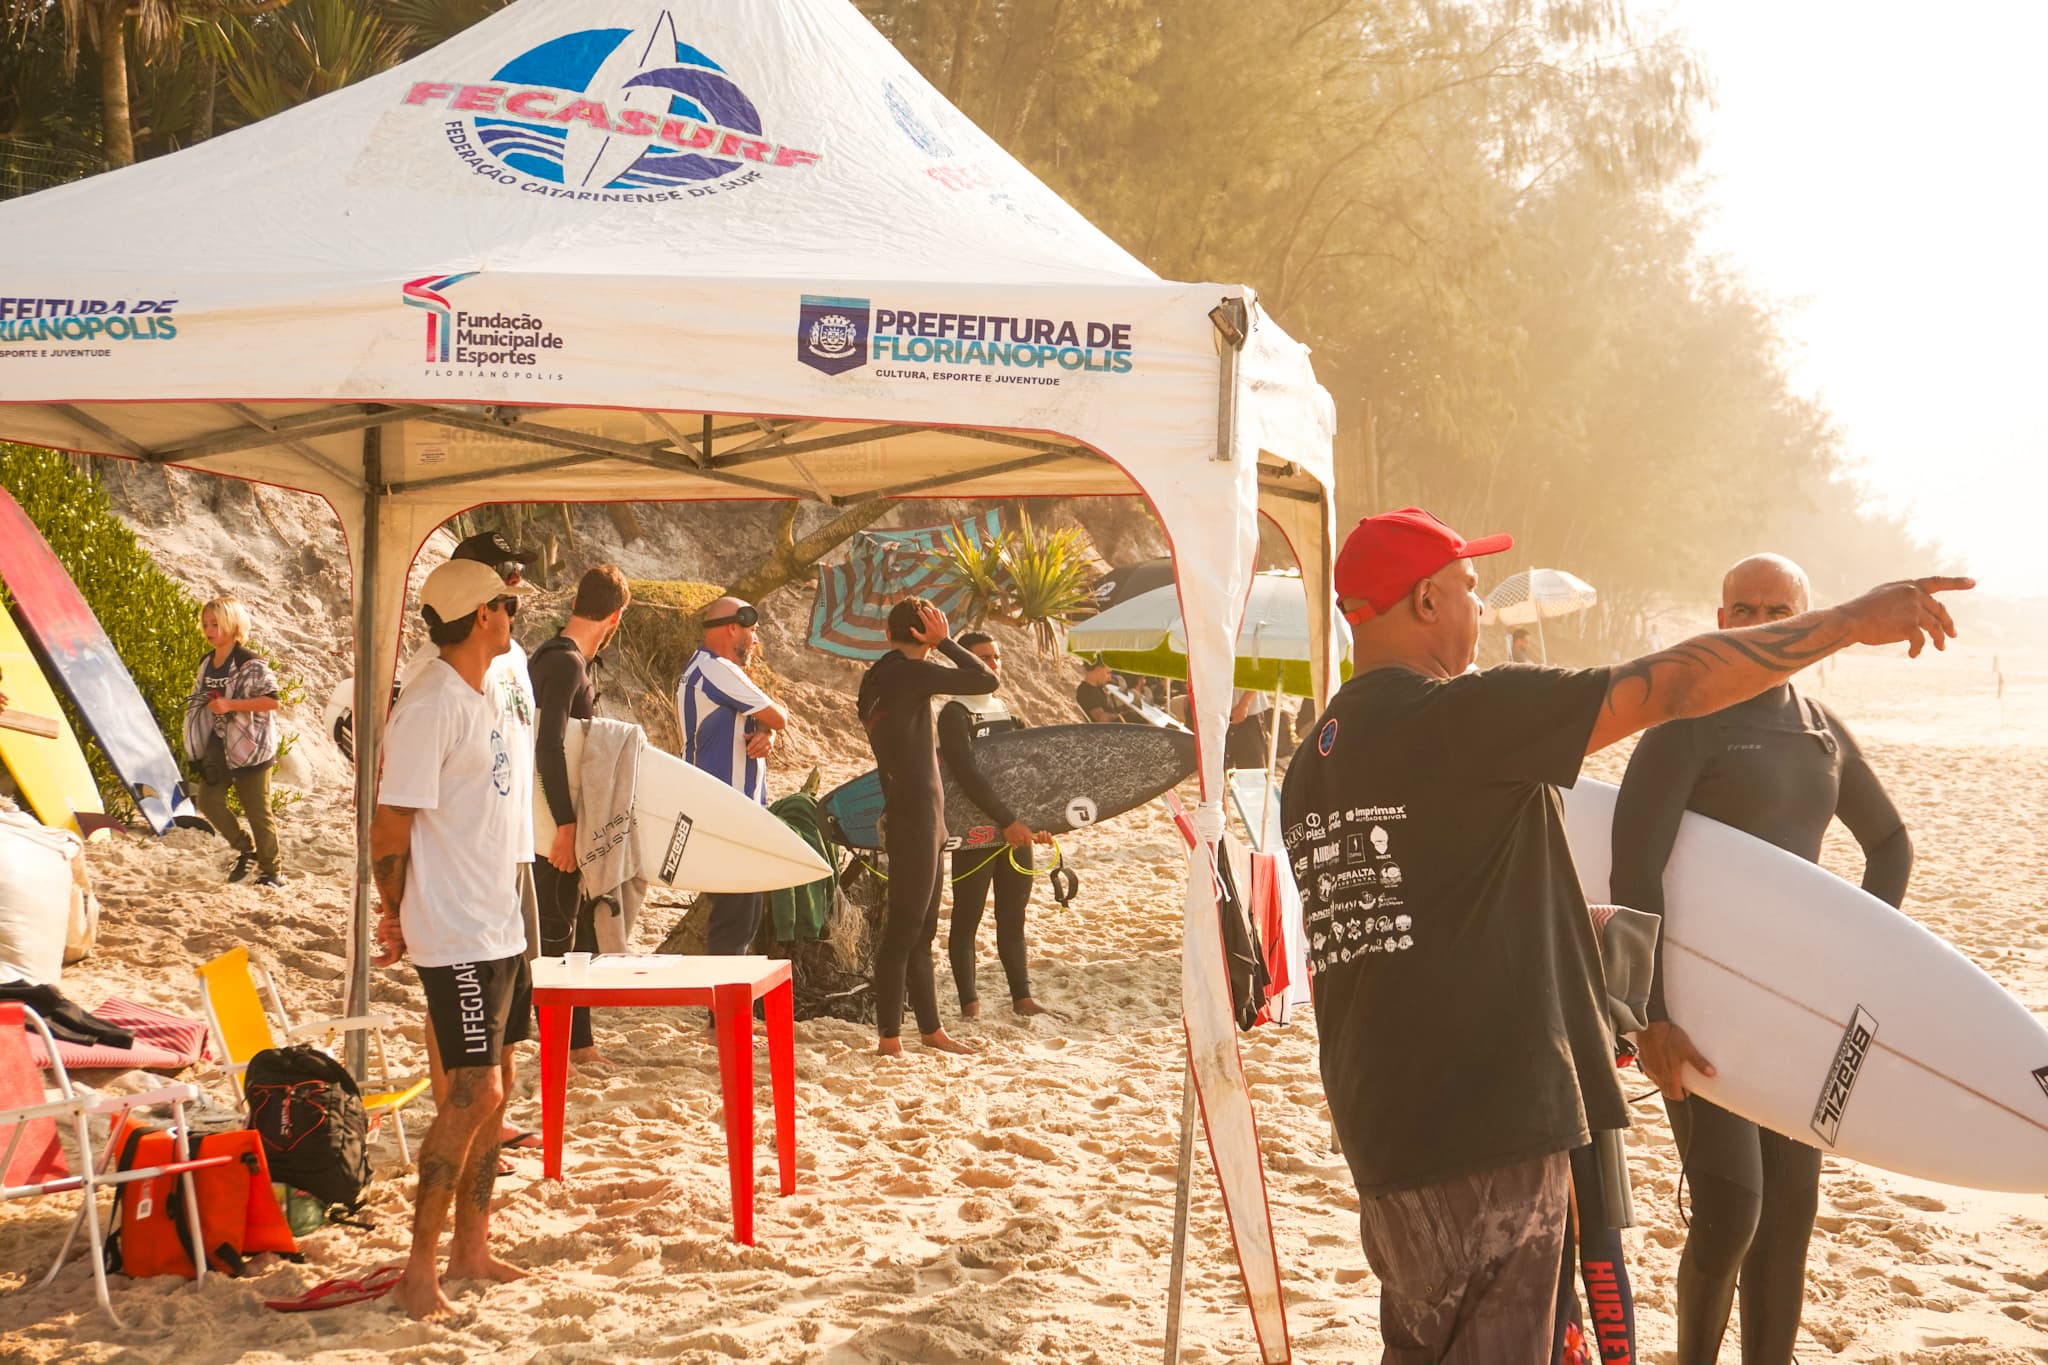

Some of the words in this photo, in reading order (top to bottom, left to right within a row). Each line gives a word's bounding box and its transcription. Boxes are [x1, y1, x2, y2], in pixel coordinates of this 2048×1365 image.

[400, 80, 823, 168] FECASURF
[445, 120, 517, 185] FEDERAÇÃO
[521, 182, 683, 203] CATARINENSE
[687, 185, 718, 198] DE
[720, 170, 766, 191] SURF
[457, 311, 543, 330] Fundação
[875, 309, 1081, 347] PREFEITURA
[1086, 321, 1132, 350] DE
[456, 329, 539, 351] Municipal
[541, 333, 564, 349] de
[41, 350, 47, 358] E
[50, 349, 112, 358] JUVENTUDE
[456, 347, 536, 367] Esportes
[875, 369, 930, 381] CULTURA,
[932, 372, 984, 383] ESPORTE
[985, 374, 992, 383] E
[995, 375, 1061, 386] JUVENTUDE
